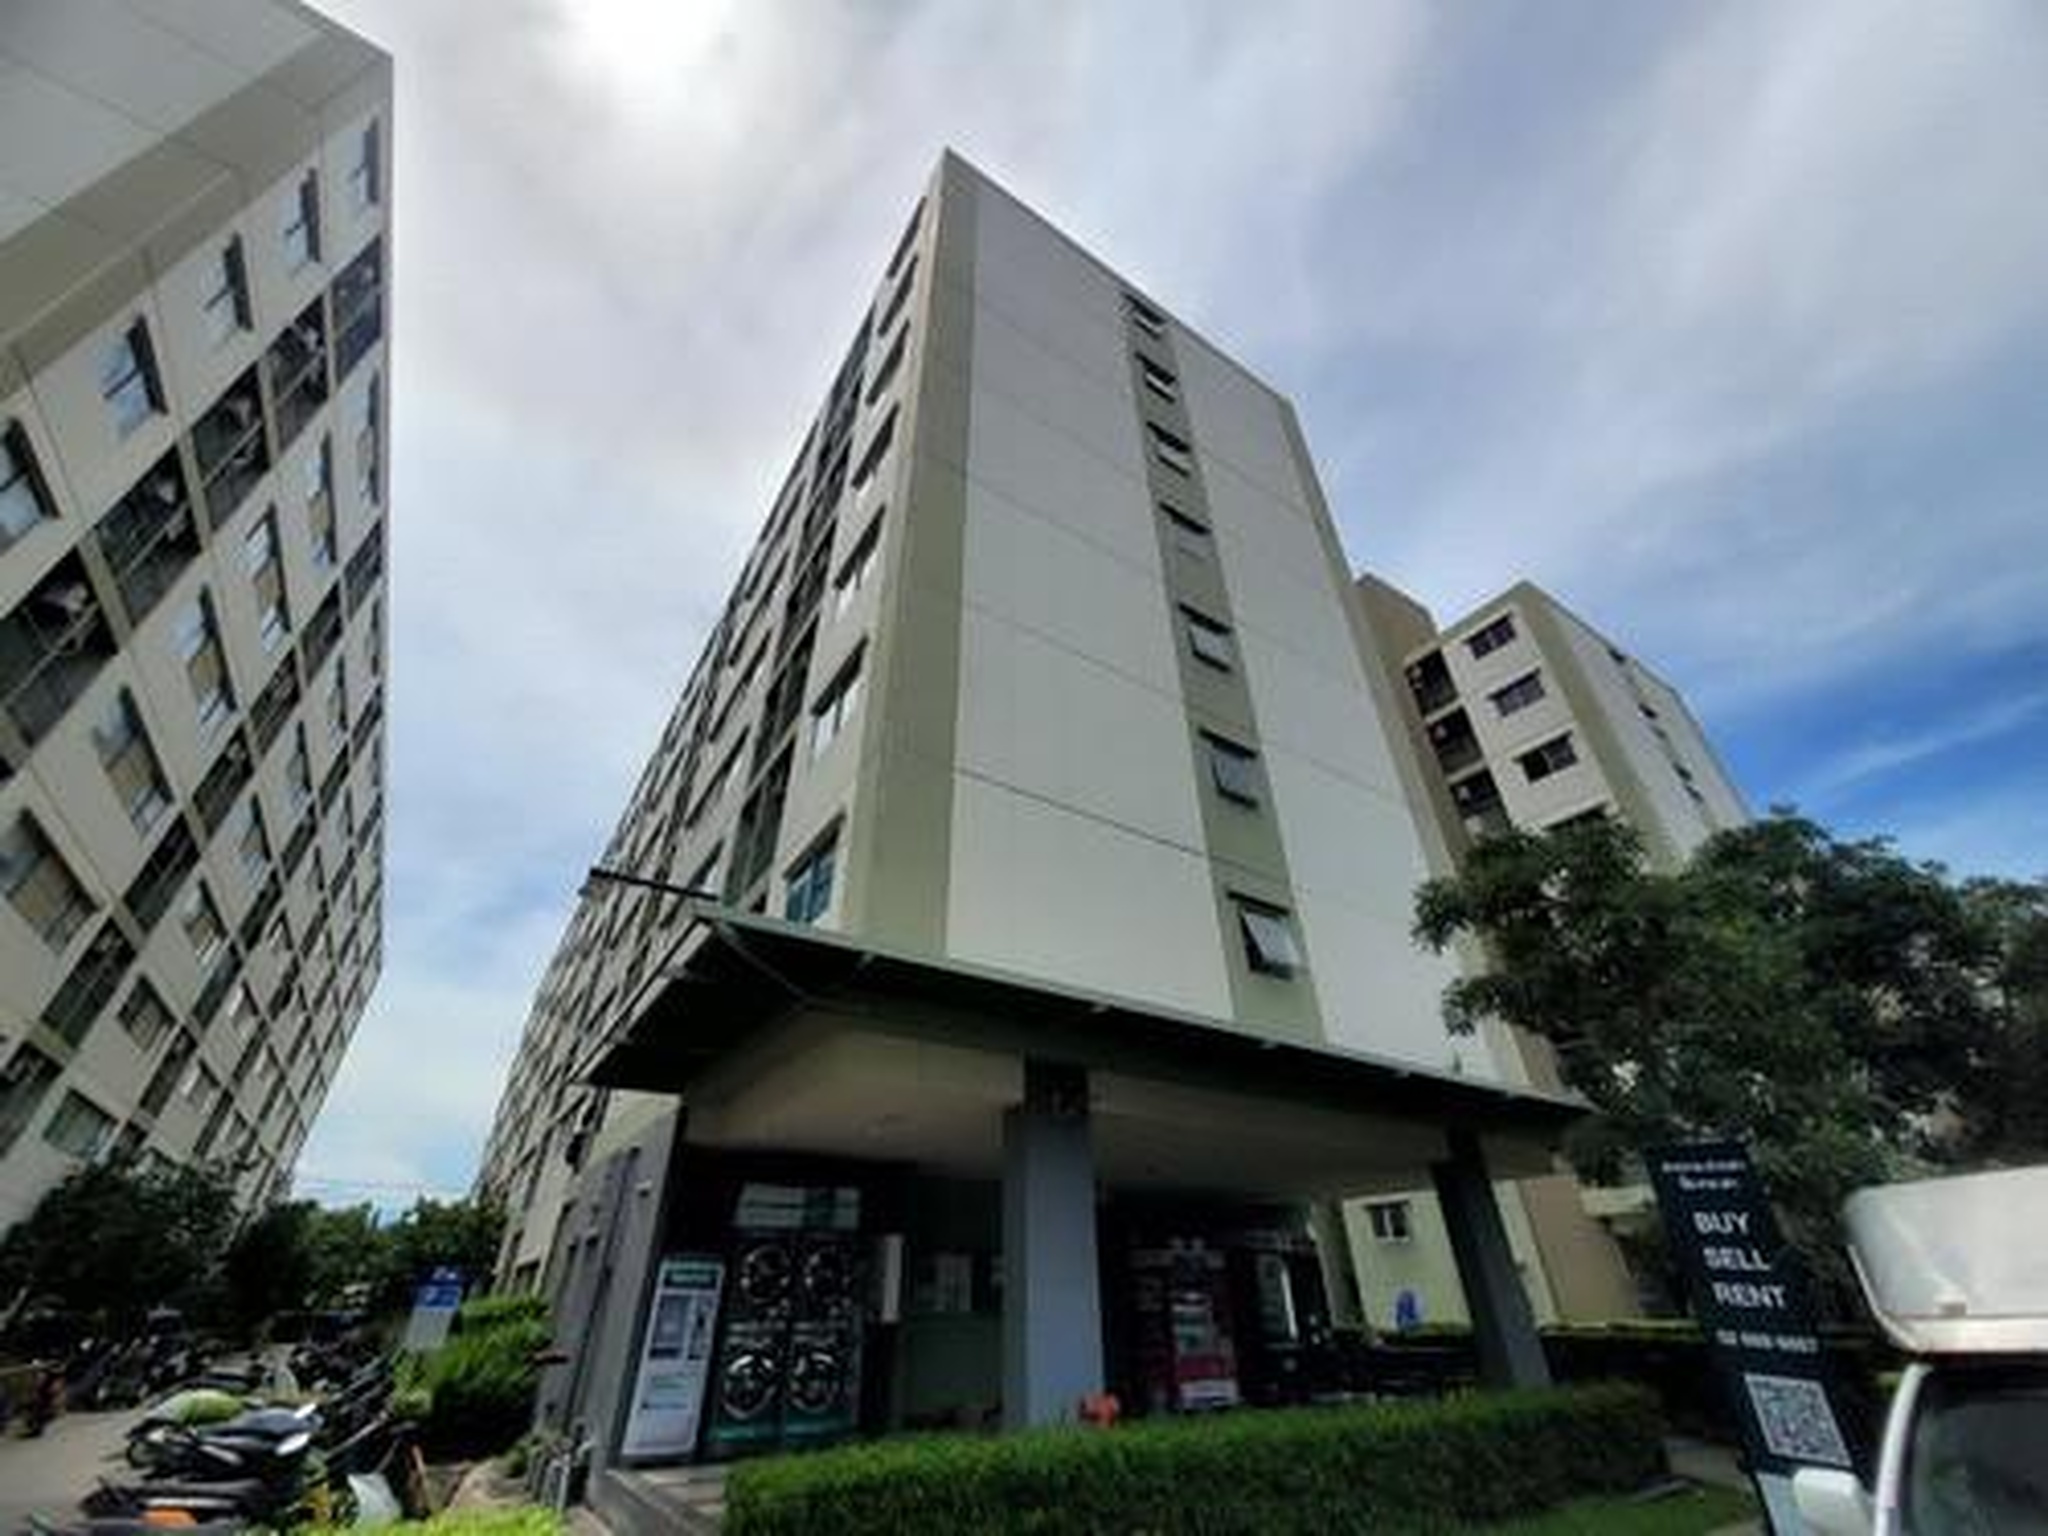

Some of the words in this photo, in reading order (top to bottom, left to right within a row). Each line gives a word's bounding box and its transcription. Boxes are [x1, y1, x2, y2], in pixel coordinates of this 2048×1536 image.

[1692, 1211, 1750, 1235] BUY
[1703, 1246, 1771, 1271] SELL
[1711, 1281, 1786, 1309] RENT
